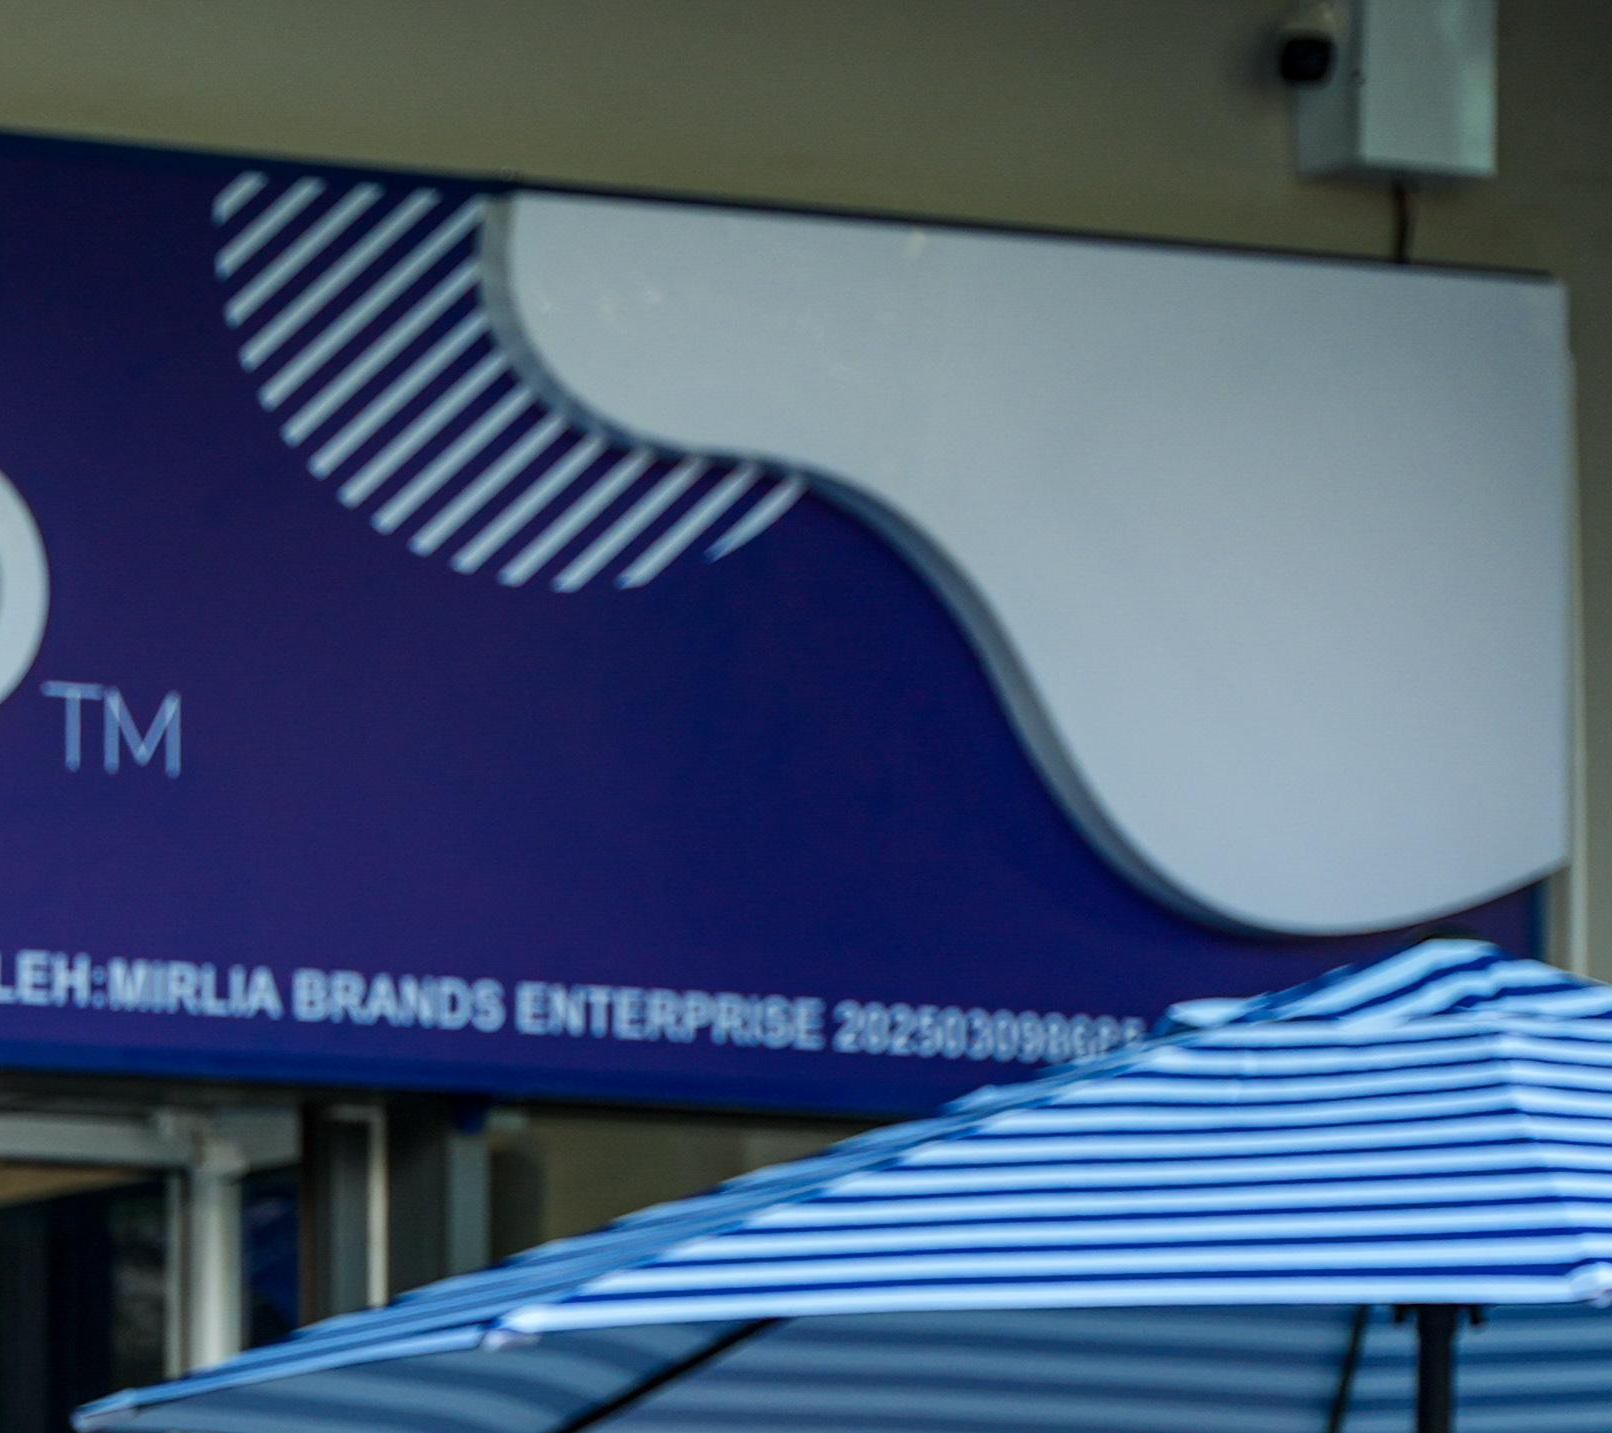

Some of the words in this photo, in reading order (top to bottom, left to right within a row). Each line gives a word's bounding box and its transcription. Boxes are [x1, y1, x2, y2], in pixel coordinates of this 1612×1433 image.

[44, 681, 182, 776] TM
[291, 966, 506, 1033] BRANDS
[513, 978, 827, 1052] ENTERPRISE
